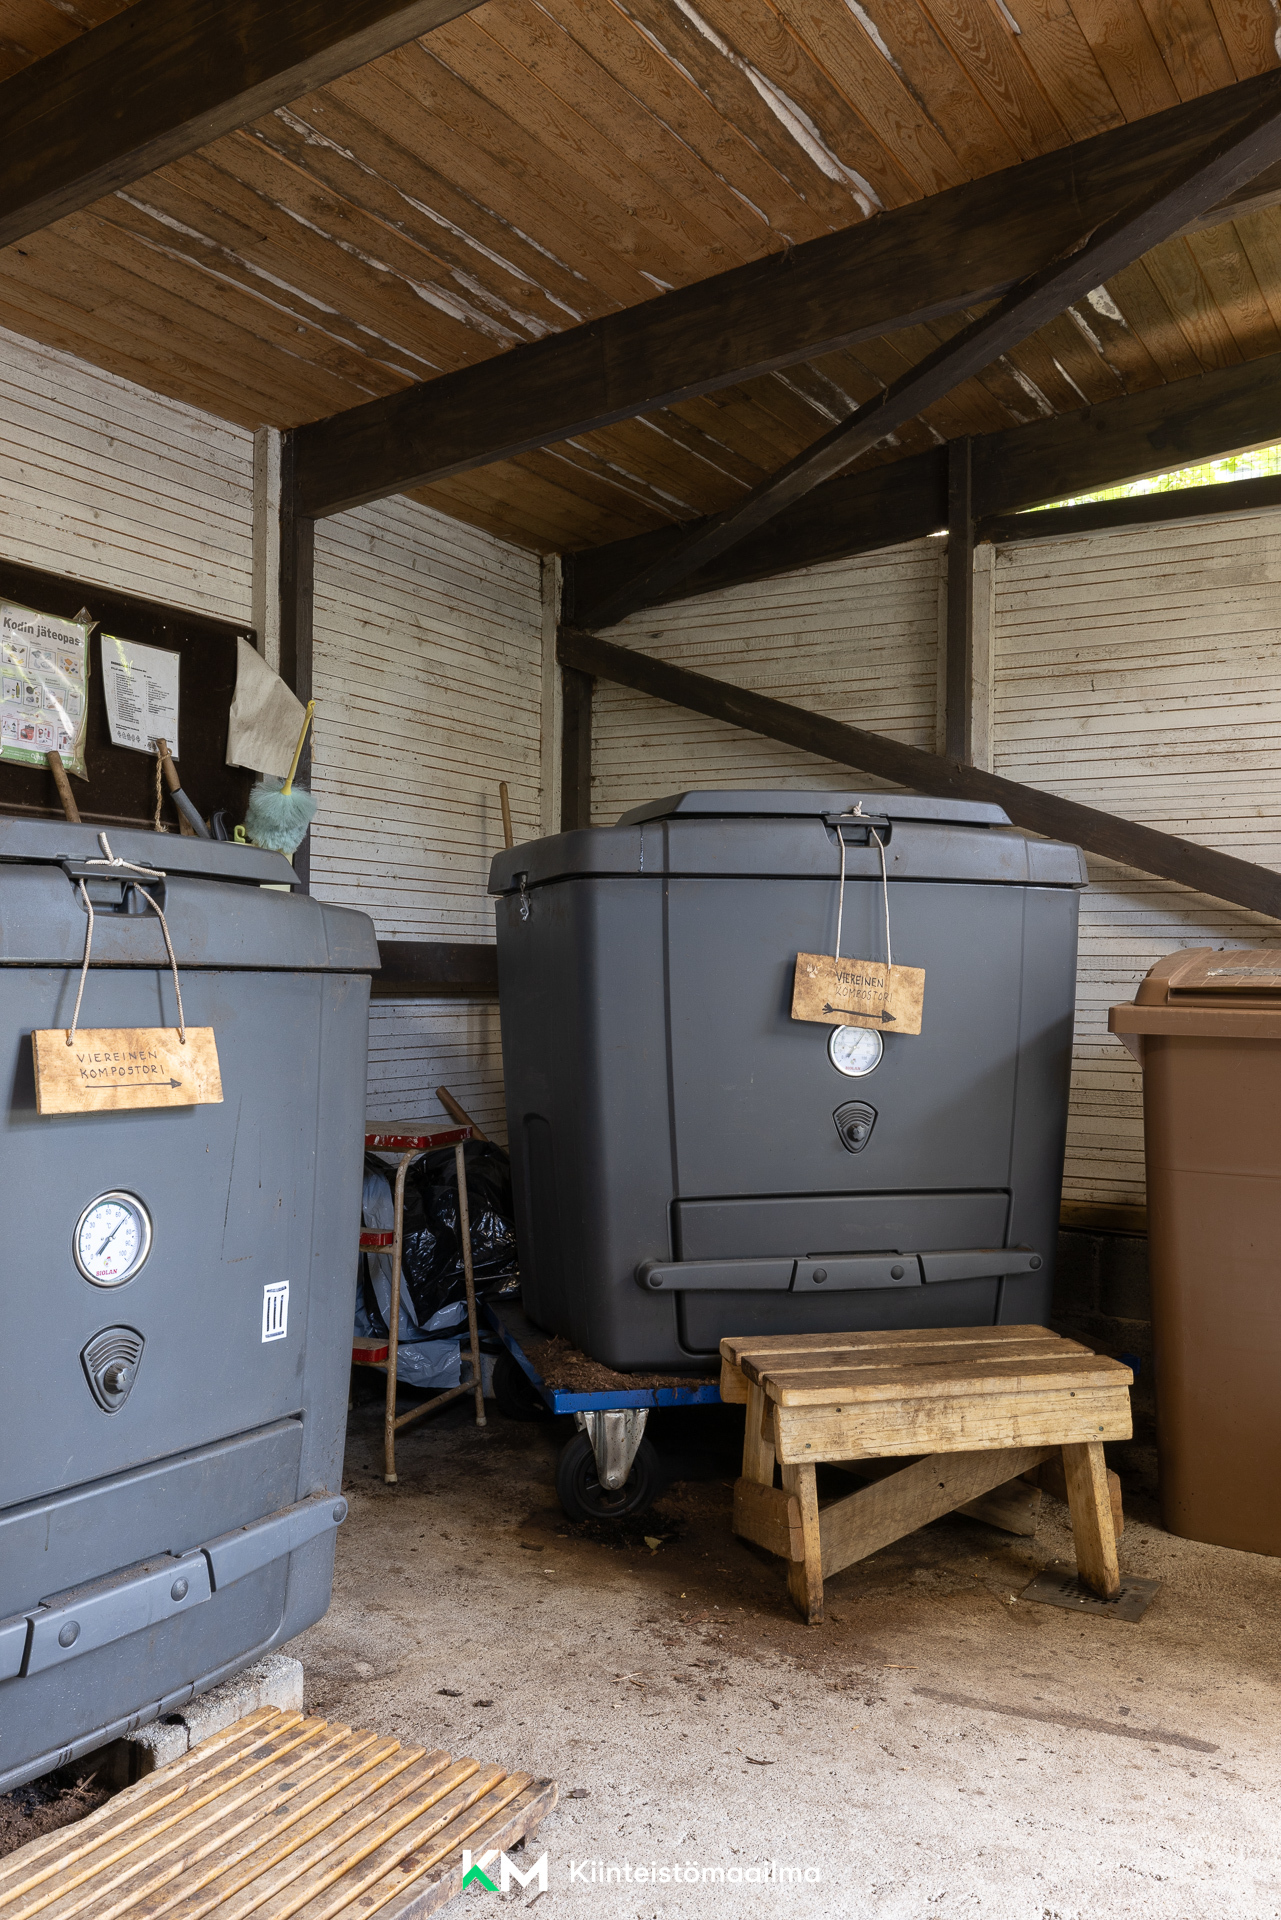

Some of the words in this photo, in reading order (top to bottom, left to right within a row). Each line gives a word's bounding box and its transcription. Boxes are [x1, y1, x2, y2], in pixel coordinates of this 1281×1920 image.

[3, 616, 35, 635] Kodin
[36, 625, 81, 647] jäteopas
[836, 971, 884, 988] VIEREINEN
[76, 1051, 158, 1063] VIEREINEN
[79, 1064, 165, 1079] KOMPOSTORI
[95, 1269, 118, 1277] BIOLAN
